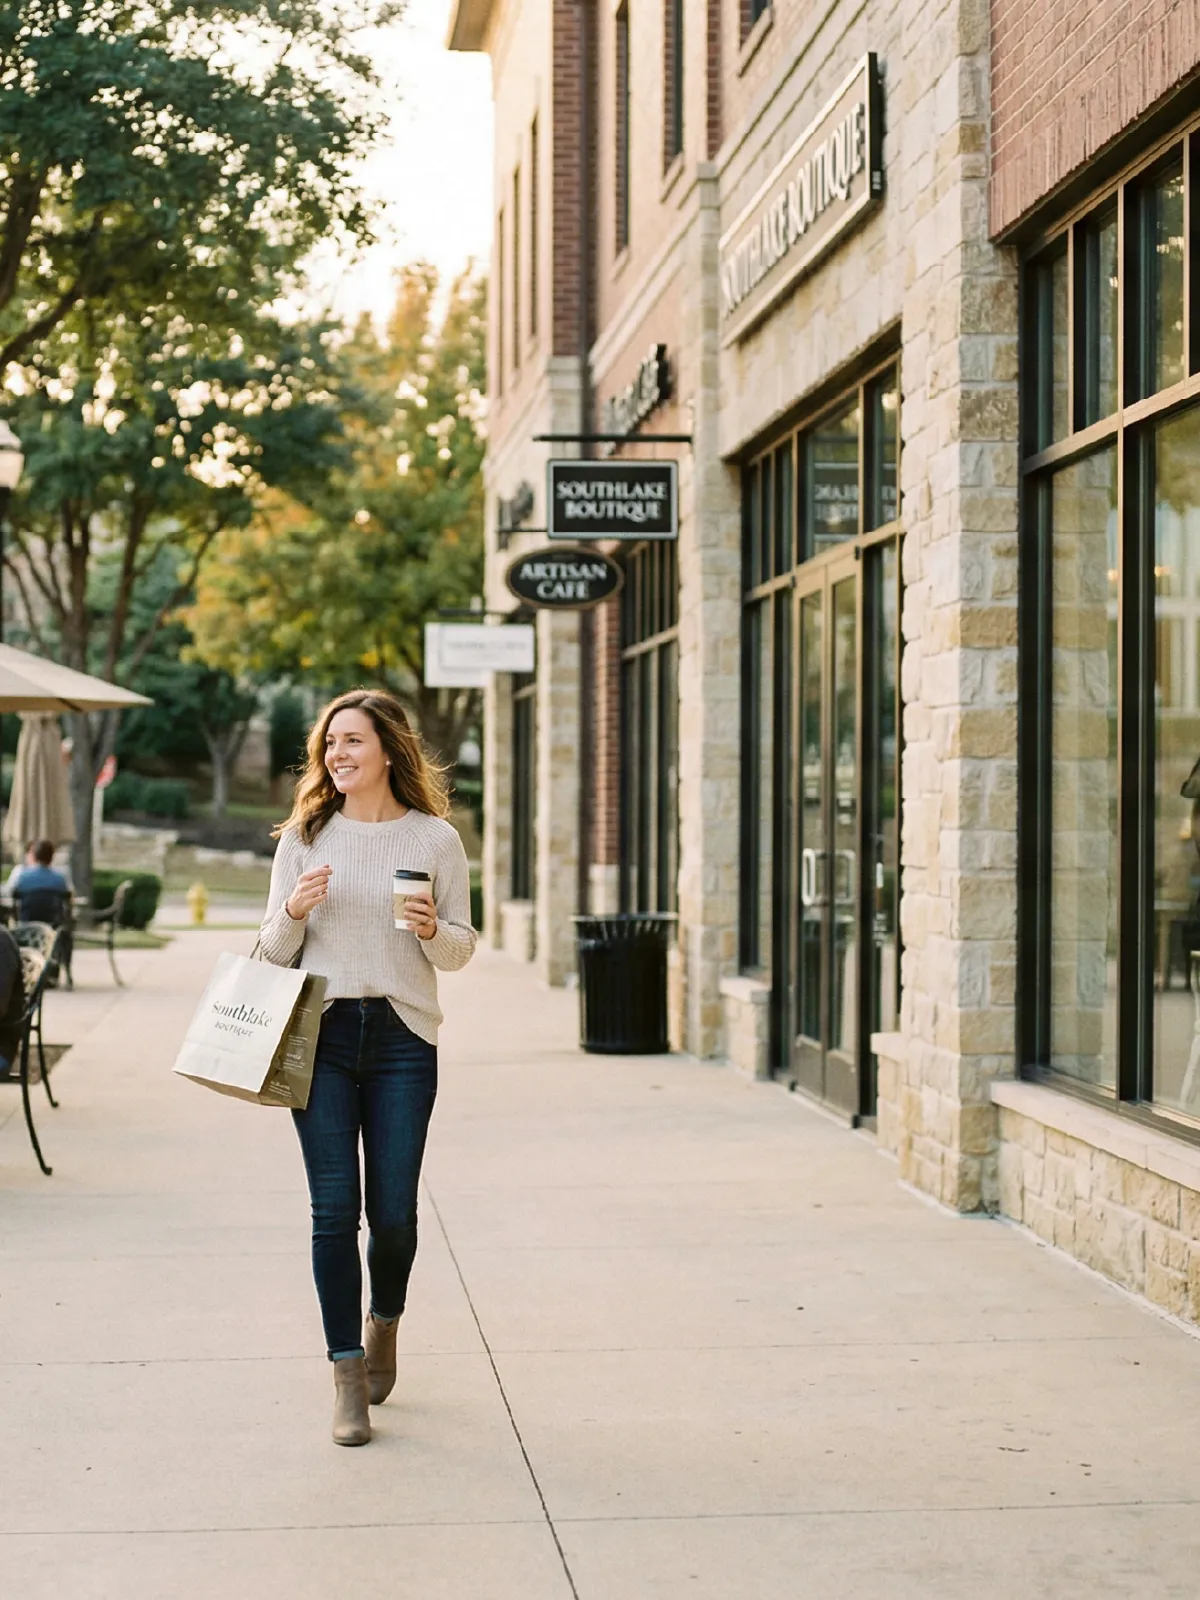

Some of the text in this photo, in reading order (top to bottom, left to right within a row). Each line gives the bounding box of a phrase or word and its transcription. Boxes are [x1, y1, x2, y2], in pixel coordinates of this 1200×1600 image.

[557, 480, 667, 500] SOUTHLAKE
[564, 501, 661, 523] BOUTIQUE
[519, 562, 607, 579] ARTISAN
